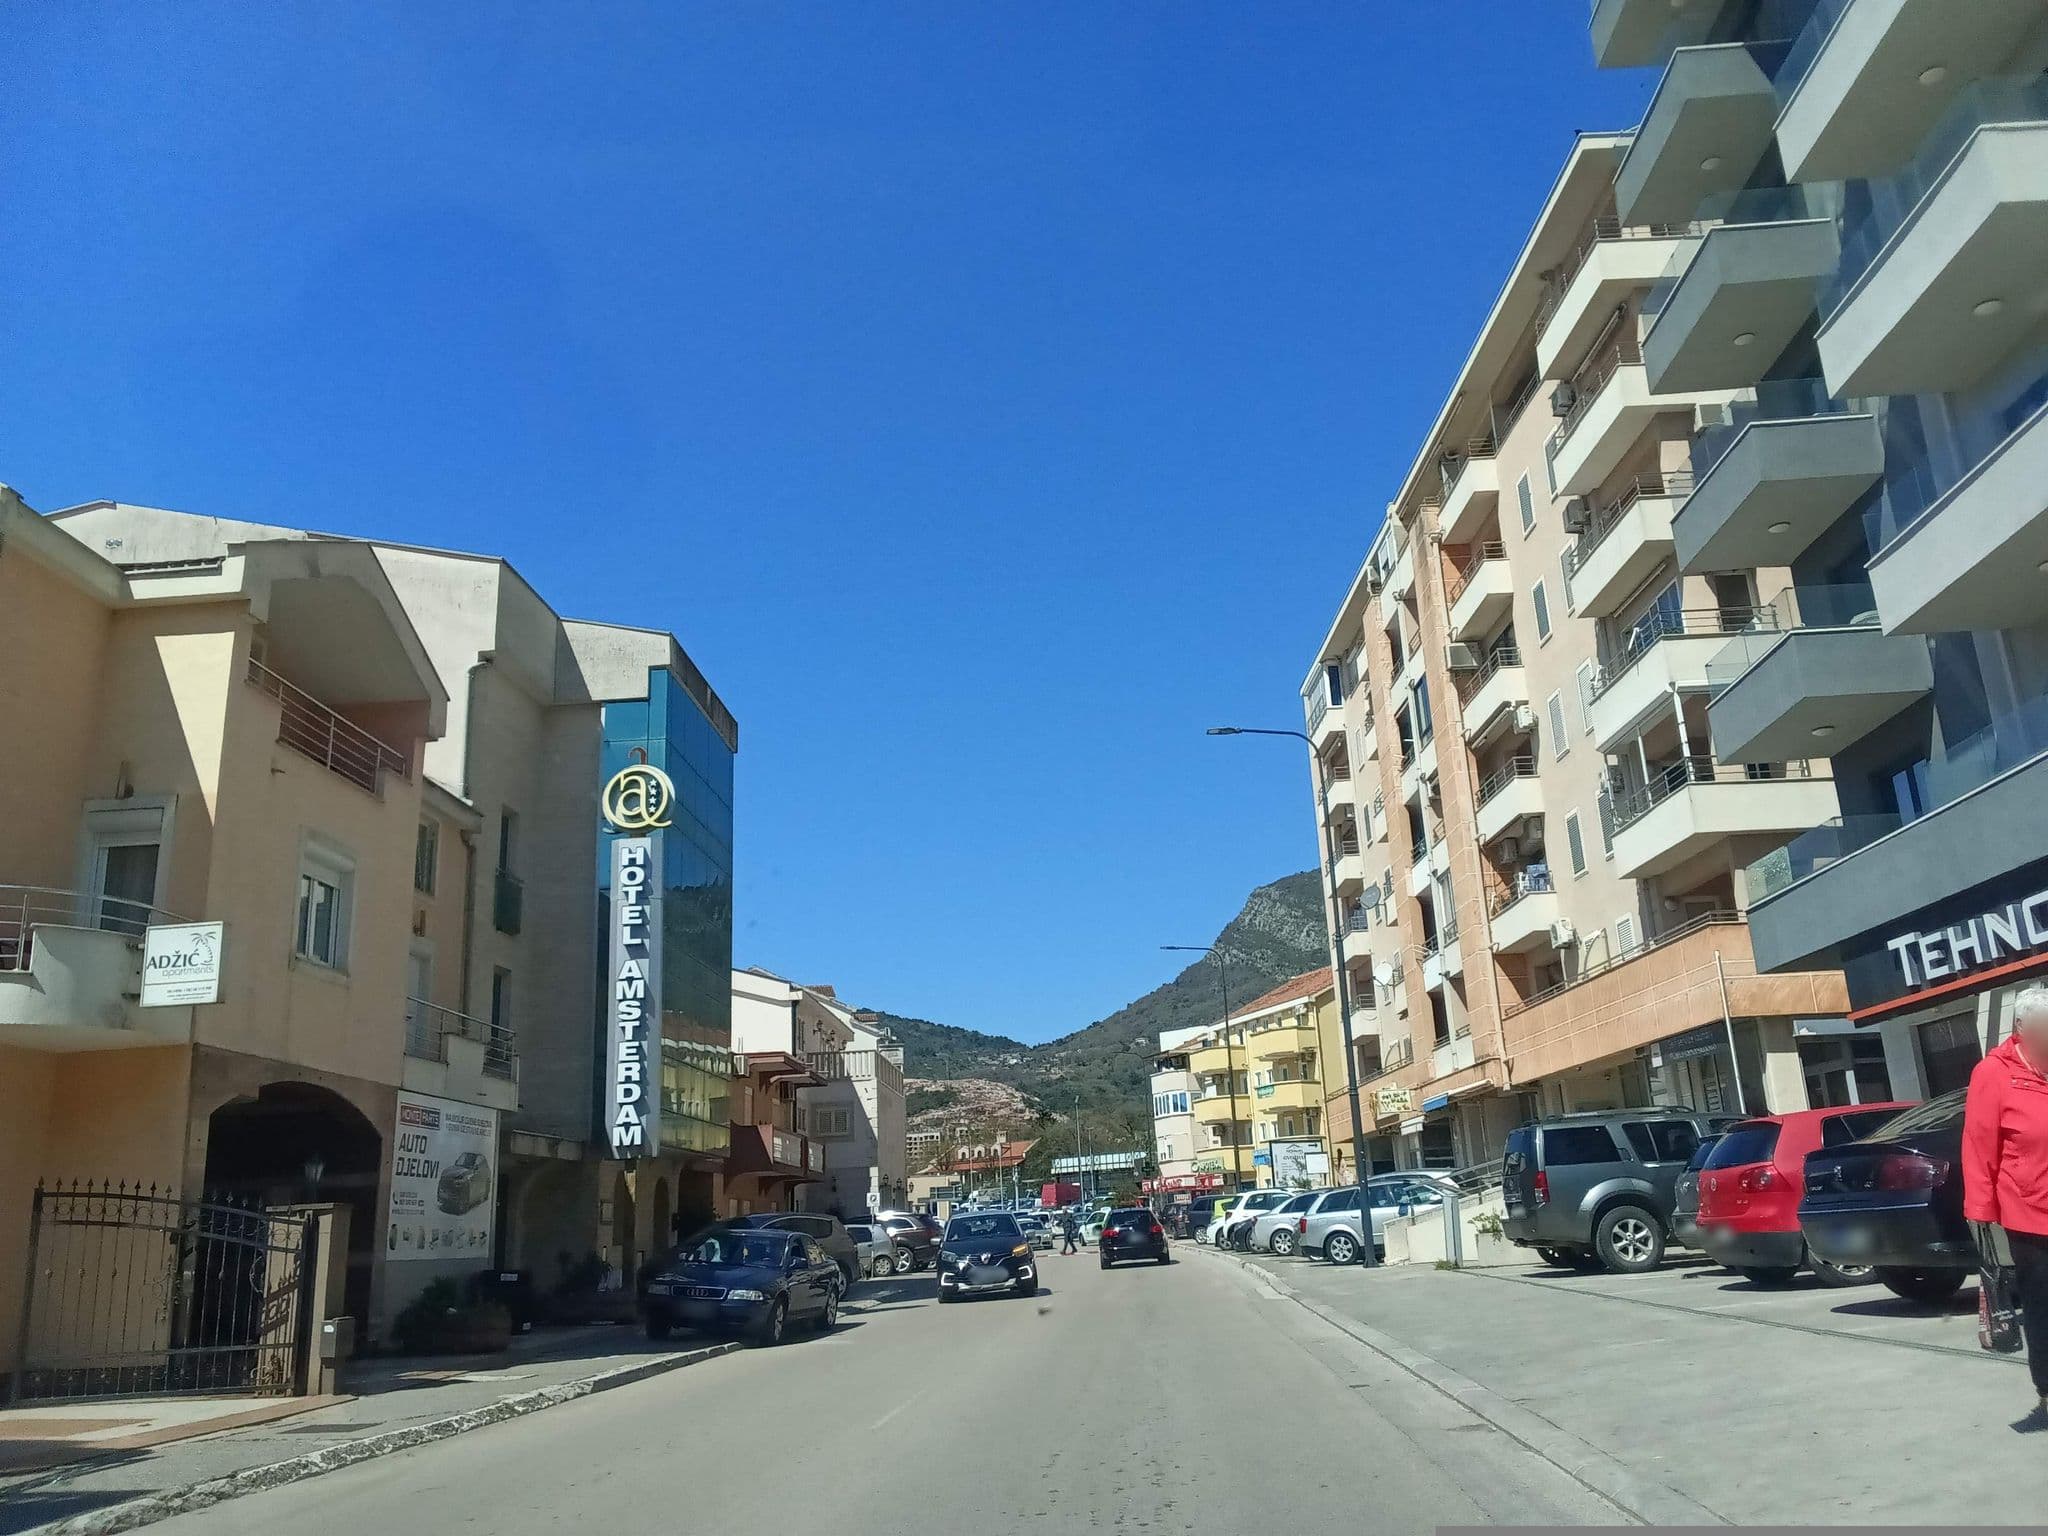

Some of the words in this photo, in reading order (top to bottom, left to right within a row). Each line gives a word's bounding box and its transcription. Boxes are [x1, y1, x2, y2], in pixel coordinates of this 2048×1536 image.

[617, 847, 645, 945] HOTEL
[146, 949, 200, 970] ADŽIĆ
[612, 959, 645, 1148] AMSTERDAM
[398, 1132, 428, 1155] AUTO
[395, 1157, 440, 1180] DJELOVI
